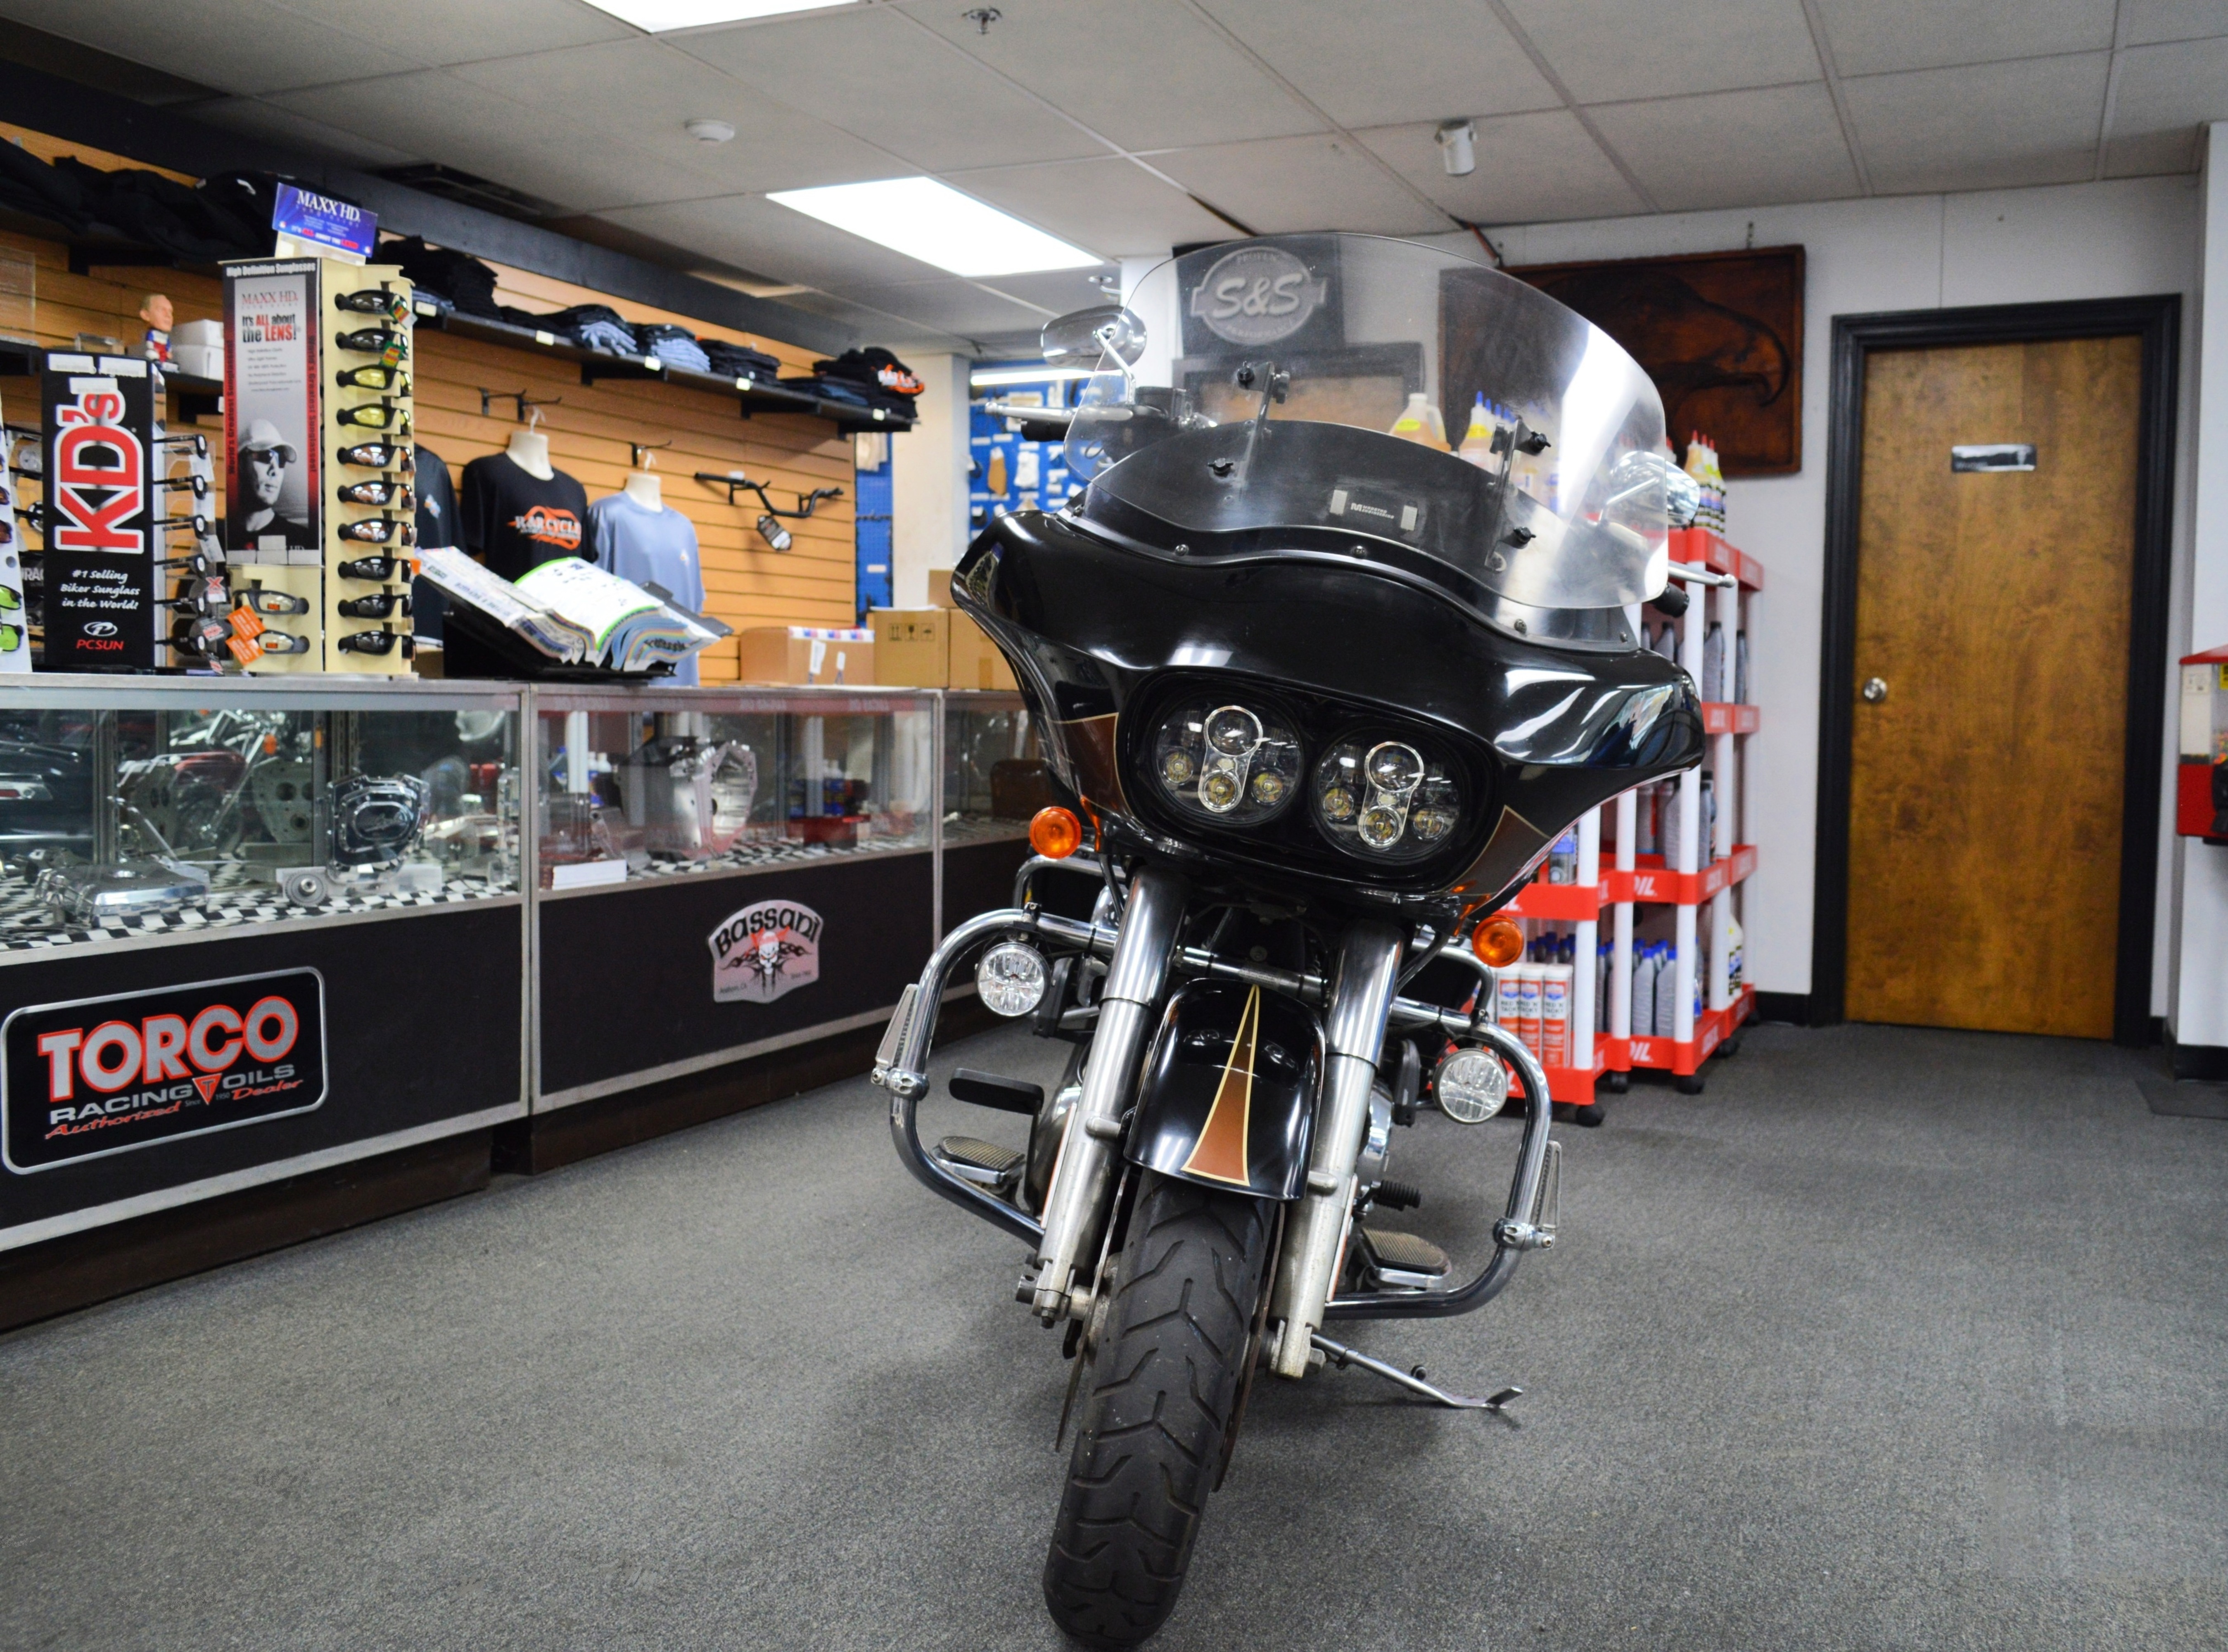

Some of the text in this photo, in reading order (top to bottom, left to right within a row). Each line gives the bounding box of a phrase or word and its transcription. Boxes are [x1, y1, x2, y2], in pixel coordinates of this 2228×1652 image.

[297, 190, 338, 216] MAXX
[226, 262, 316, 277] High Definition Sunglasses
[242, 292, 277, 305] MAXX
[1212, 273, 1303, 318] S&S
[256, 314, 269, 326] ALL
[272, 313, 296, 325] about
[242, 323, 297, 343] the LENS!
[56, 392, 142, 551] KD's
[72, 570, 128, 584] #1 Selling
[60, 583, 140, 598] Biker Sunglass
[62, 598, 139, 610] in the World!
[76, 639, 124, 650] PCSUN
[37, 995, 299, 1102] TORCO
[50, 1084, 193, 1125] RACING
[223, 1064, 296, 1089] OILS
[231, 1079, 304, 1101] Dealer
[185, 1099, 201, 1107] Since
[45, 1101, 183, 1139] Authorized
